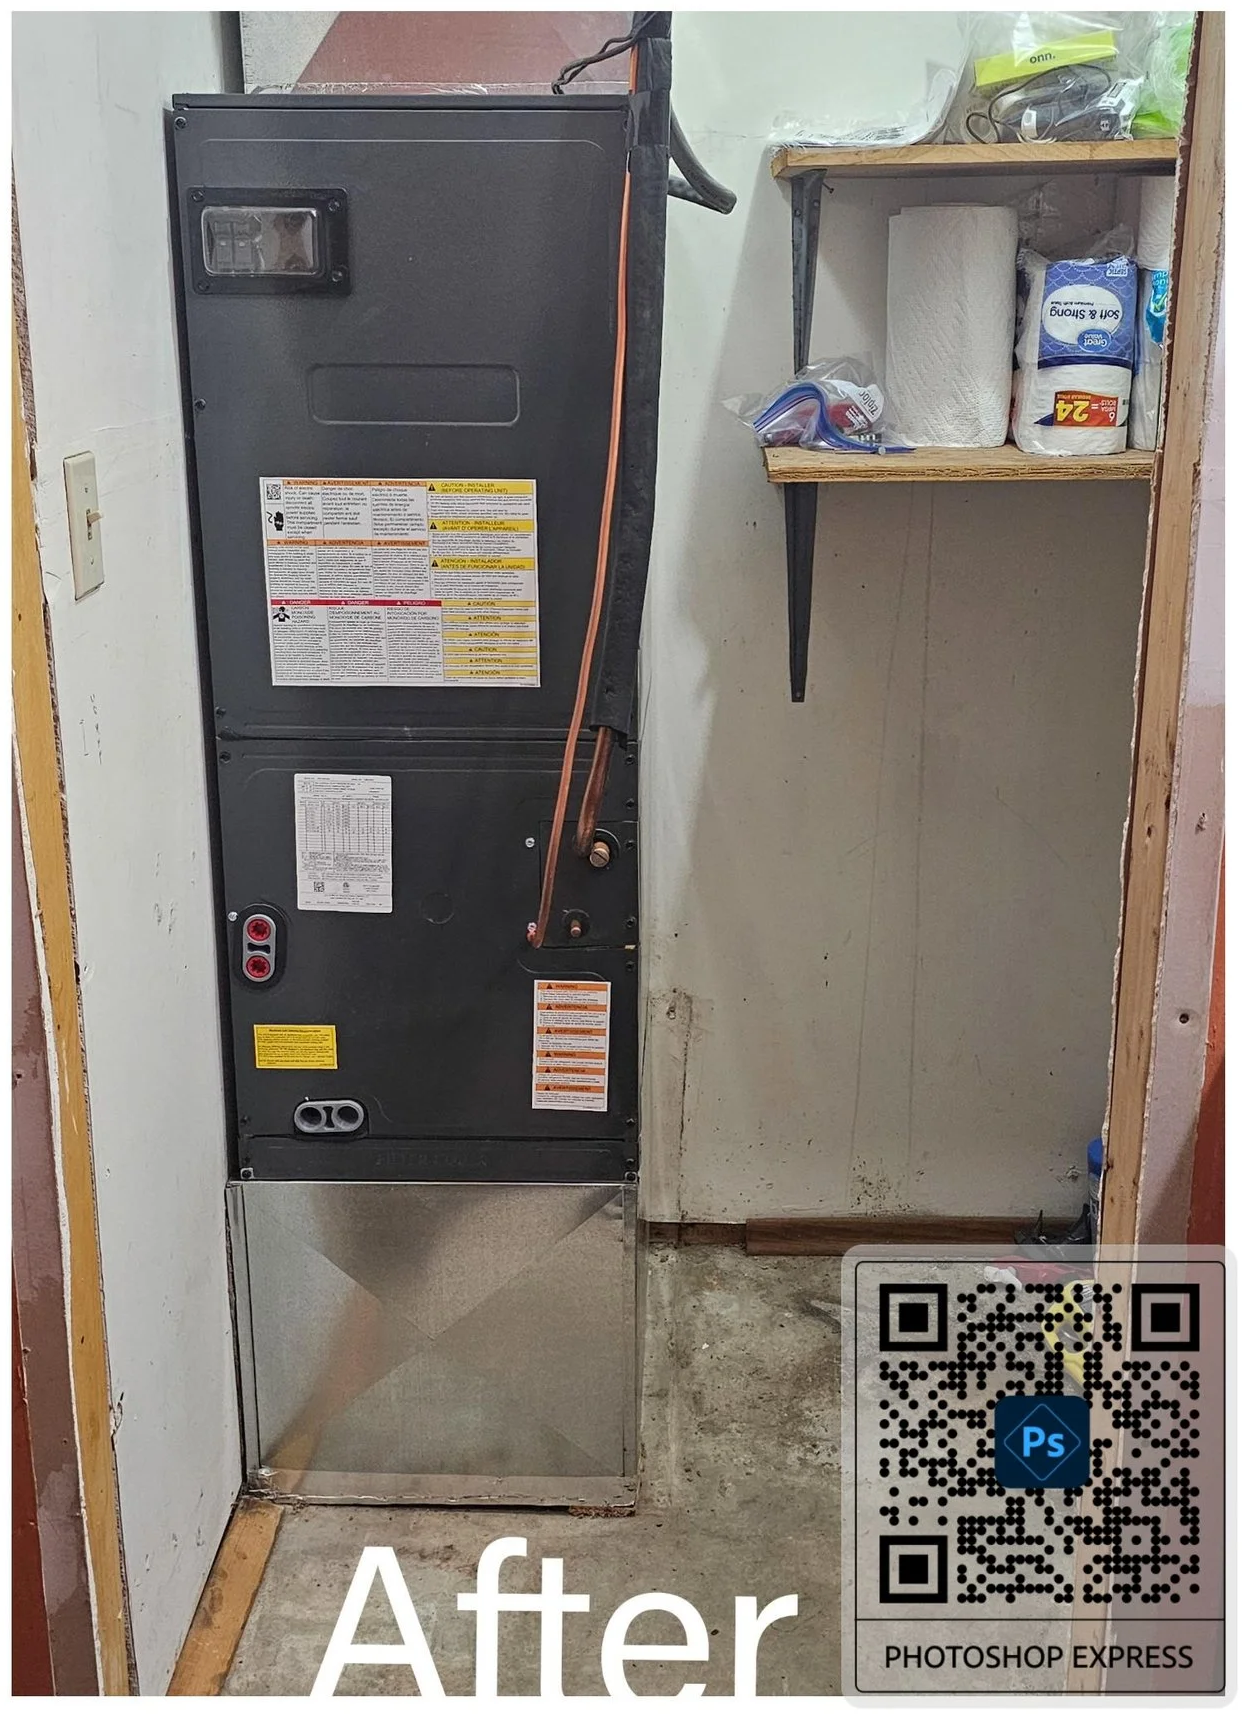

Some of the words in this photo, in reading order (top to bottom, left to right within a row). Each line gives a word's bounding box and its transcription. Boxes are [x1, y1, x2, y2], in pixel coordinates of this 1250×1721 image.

[1029, 51, 1057, 65] onn.
[1049, 306, 1087, 321] Strong
[1100, 309, 1121, 320] Soft
[1055, 399, 1090, 423] 24
[1108, 411, 1116, 423] 6
